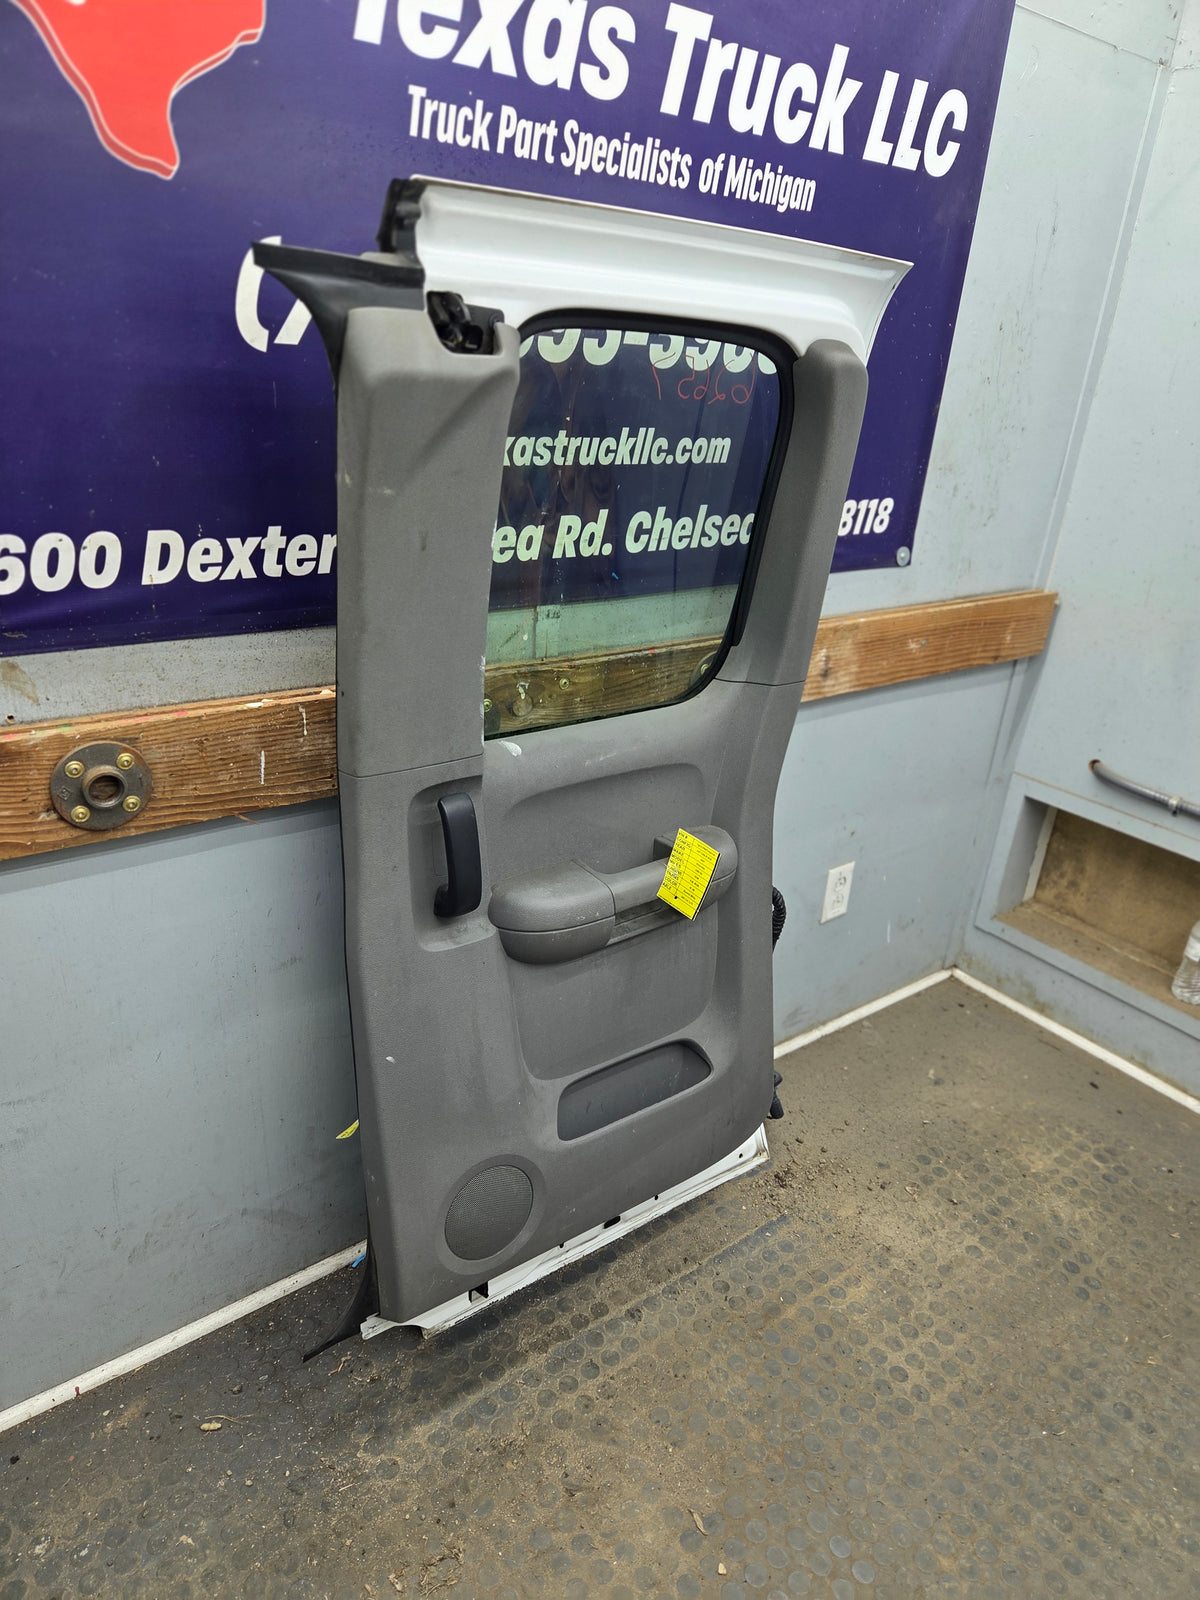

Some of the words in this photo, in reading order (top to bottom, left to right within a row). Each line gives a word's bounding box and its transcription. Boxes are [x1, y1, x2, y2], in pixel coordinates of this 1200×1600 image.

[408, 84, 493, 152] Truck
[496, 105, 560, 168] Part
[558, 119, 693, 190] Specialists
[698, 153, 727, 196] of
[723, 155, 816, 213] Michigan
[660, 2, 863, 156] Truck
[863, 70, 968, 178] LLC
[142, 526, 337, 586] Dexter
[552, 508, 613, 559] Rd.
